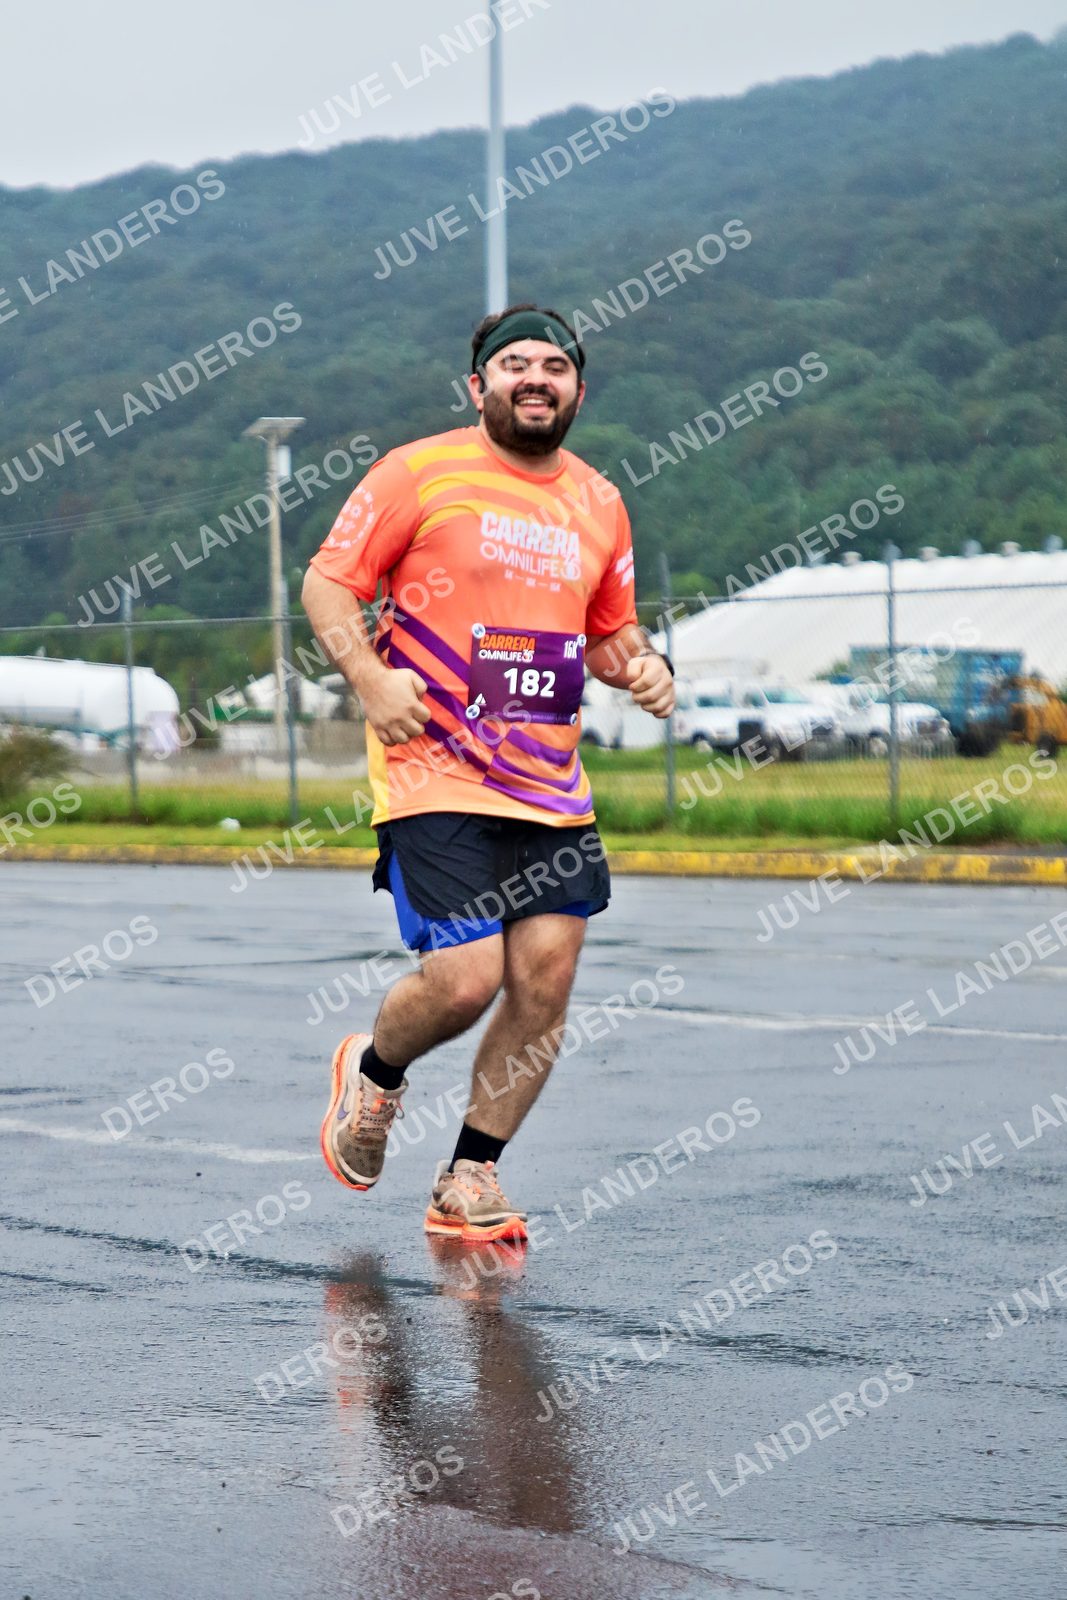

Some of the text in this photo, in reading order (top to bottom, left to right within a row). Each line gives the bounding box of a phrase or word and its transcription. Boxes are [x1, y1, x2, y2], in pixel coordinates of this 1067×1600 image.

[480, 511, 580, 561] CARRERA
[479, 541, 560, 579] OMNILIFE
[479, 633, 536, 652] CARRERA
[479, 649, 523, 662] OMNILIFE
[503, 667, 557, 698] 182
